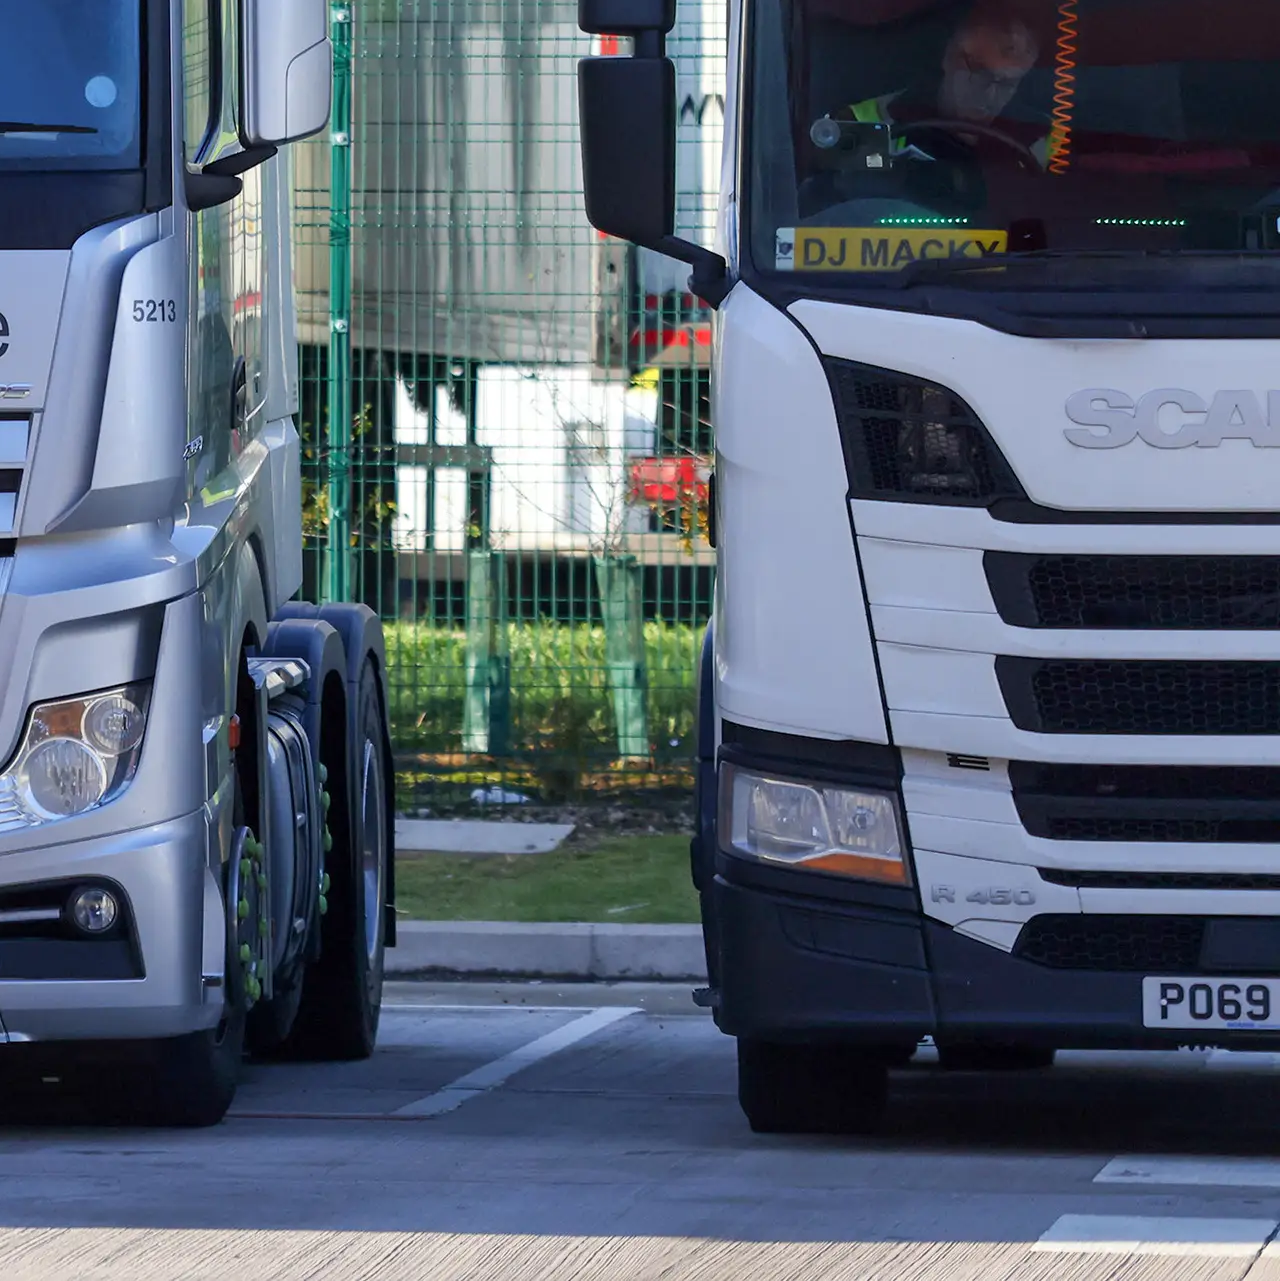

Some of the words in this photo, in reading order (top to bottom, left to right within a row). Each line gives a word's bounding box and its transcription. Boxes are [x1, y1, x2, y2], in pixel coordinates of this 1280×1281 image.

[803, 237, 847, 267] DJ
[132, 299, 177, 323] 5213
[1062, 387, 1280, 450] SCA
[931, 884, 956, 904] R
[965, 886, 1037, 906] 450
[1159, 982, 1271, 1022] PO69
